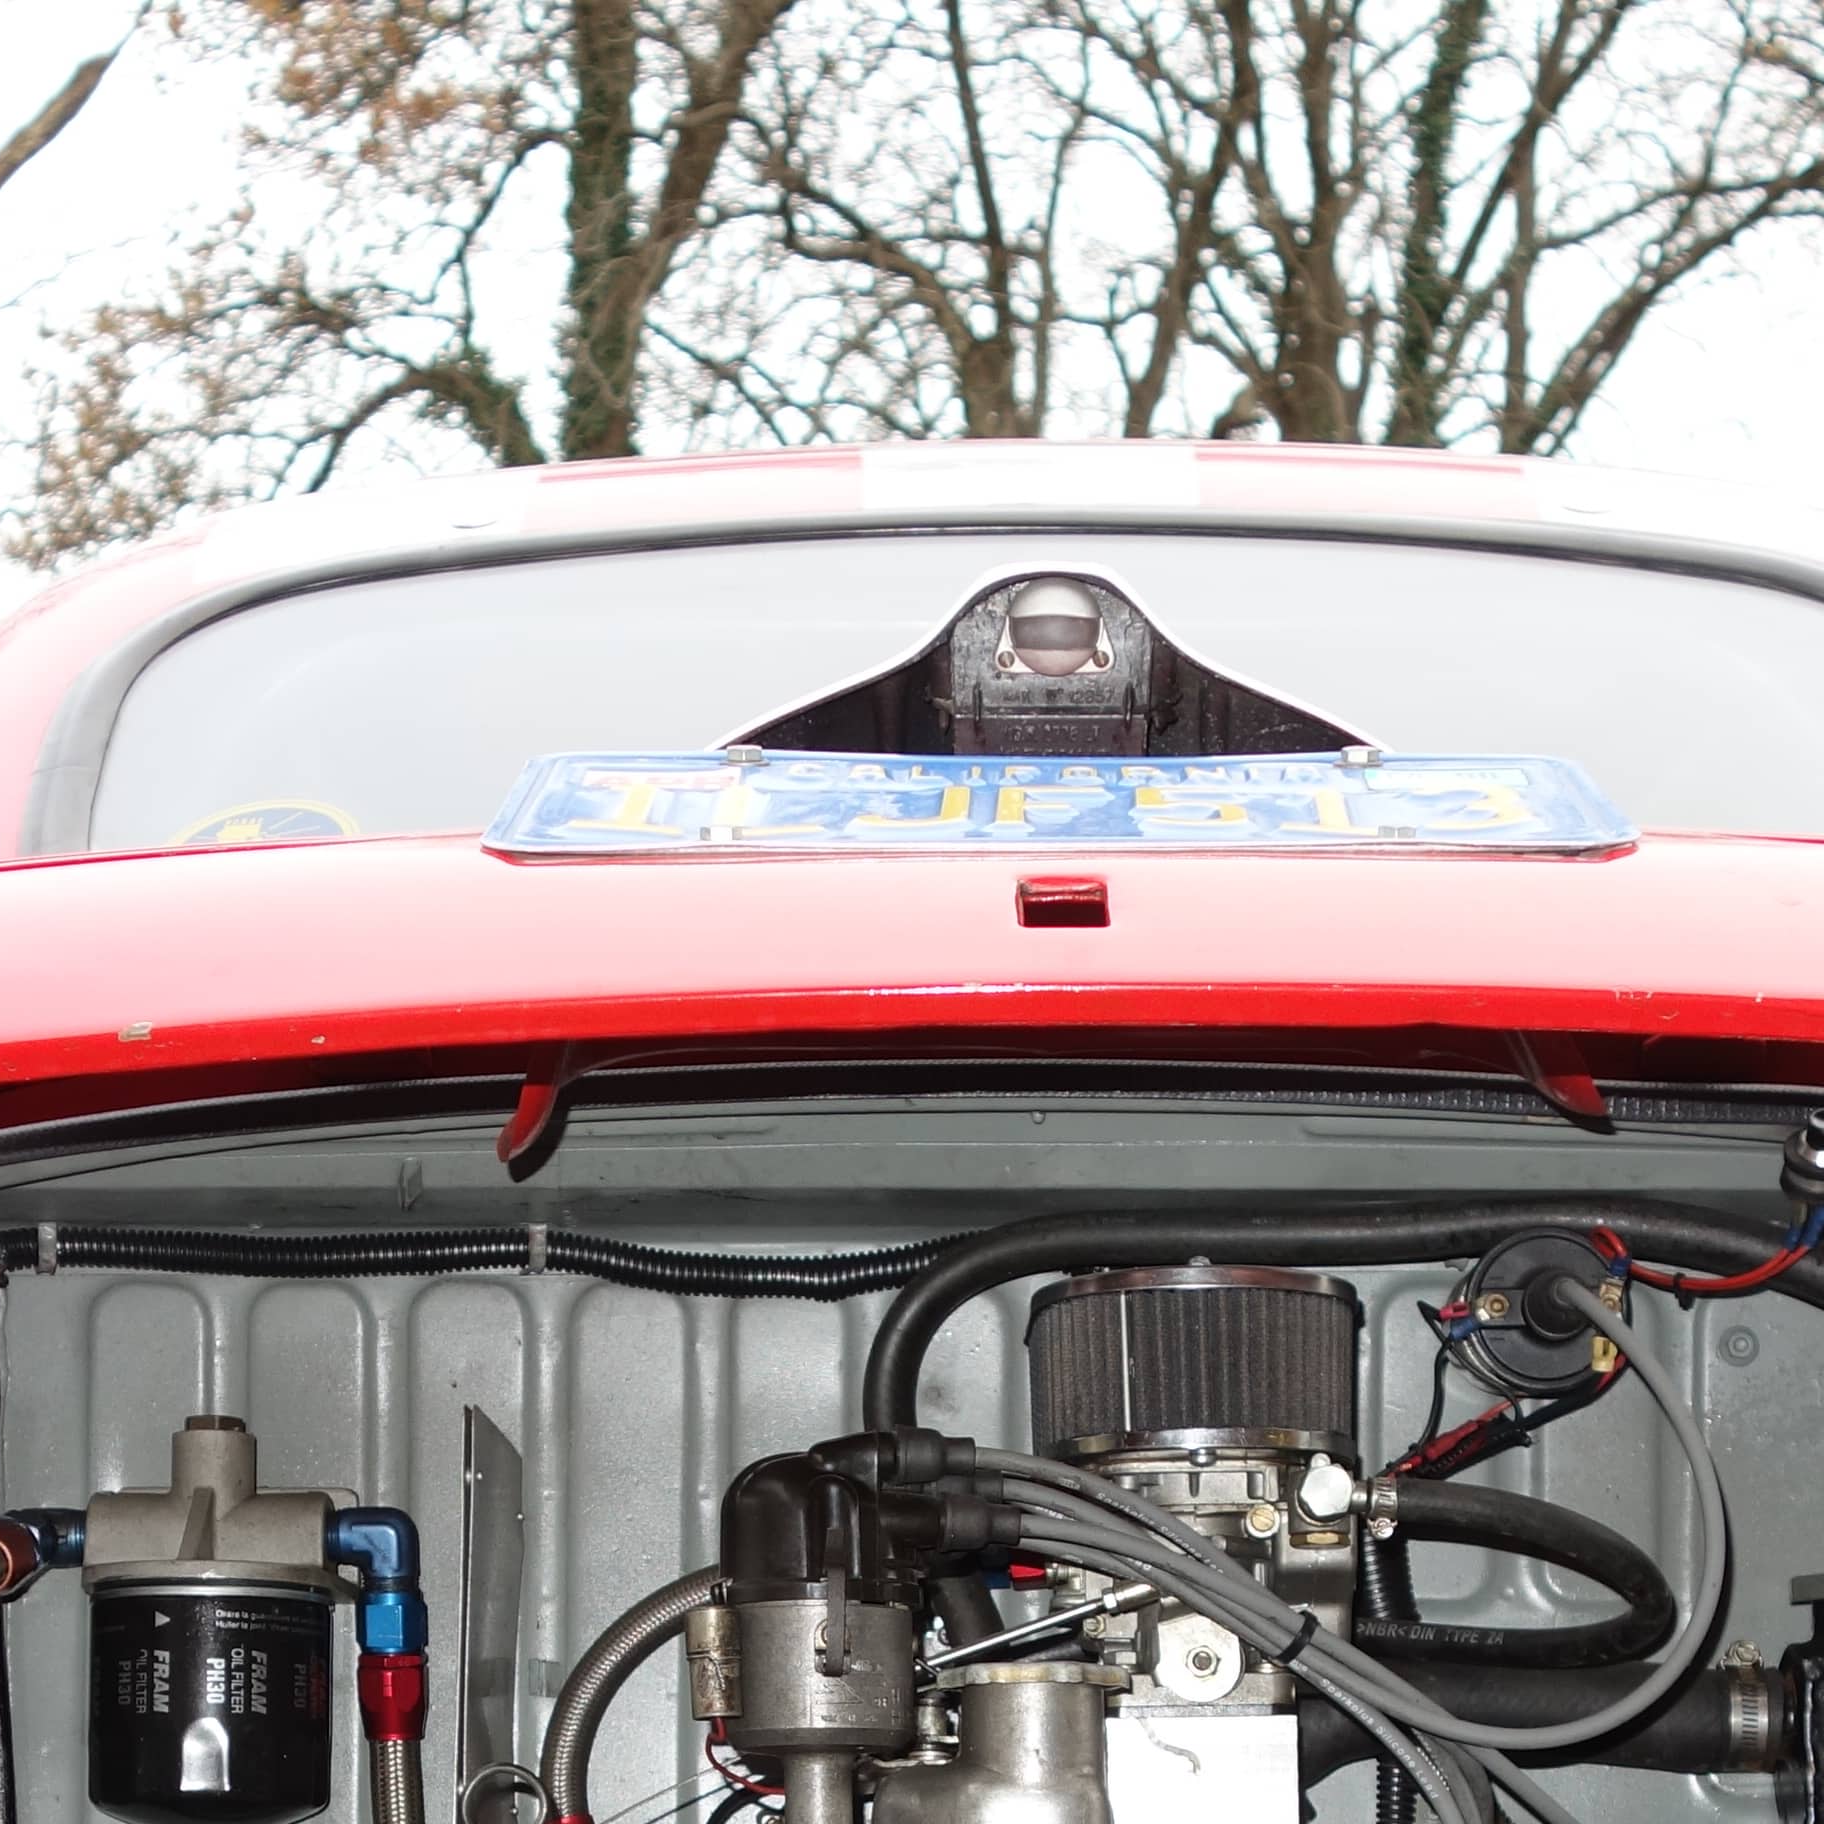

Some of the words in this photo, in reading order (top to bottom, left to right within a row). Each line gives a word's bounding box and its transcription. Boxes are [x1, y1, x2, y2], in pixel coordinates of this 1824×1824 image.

[787, 762, 1336, 786] CALIFORNIA
[1410, 1624, 1436, 1641] DIN
[1445, 1628, 1480, 1644] TYPE
[152, 1648, 171, 1714] FRAM
[206, 1657, 226, 1704] PH30
[230, 1647, 244, 1670] OIL
[117, 1660, 132, 1706] PH30
[134, 1671, 147, 1714] FILTER
[230, 1671, 244, 1715] FILTER
[251, 1649, 268, 1715] FRAM
[293, 1663, 307, 1709] PH30
[1375, 1724, 1417, 1770] Silicone
